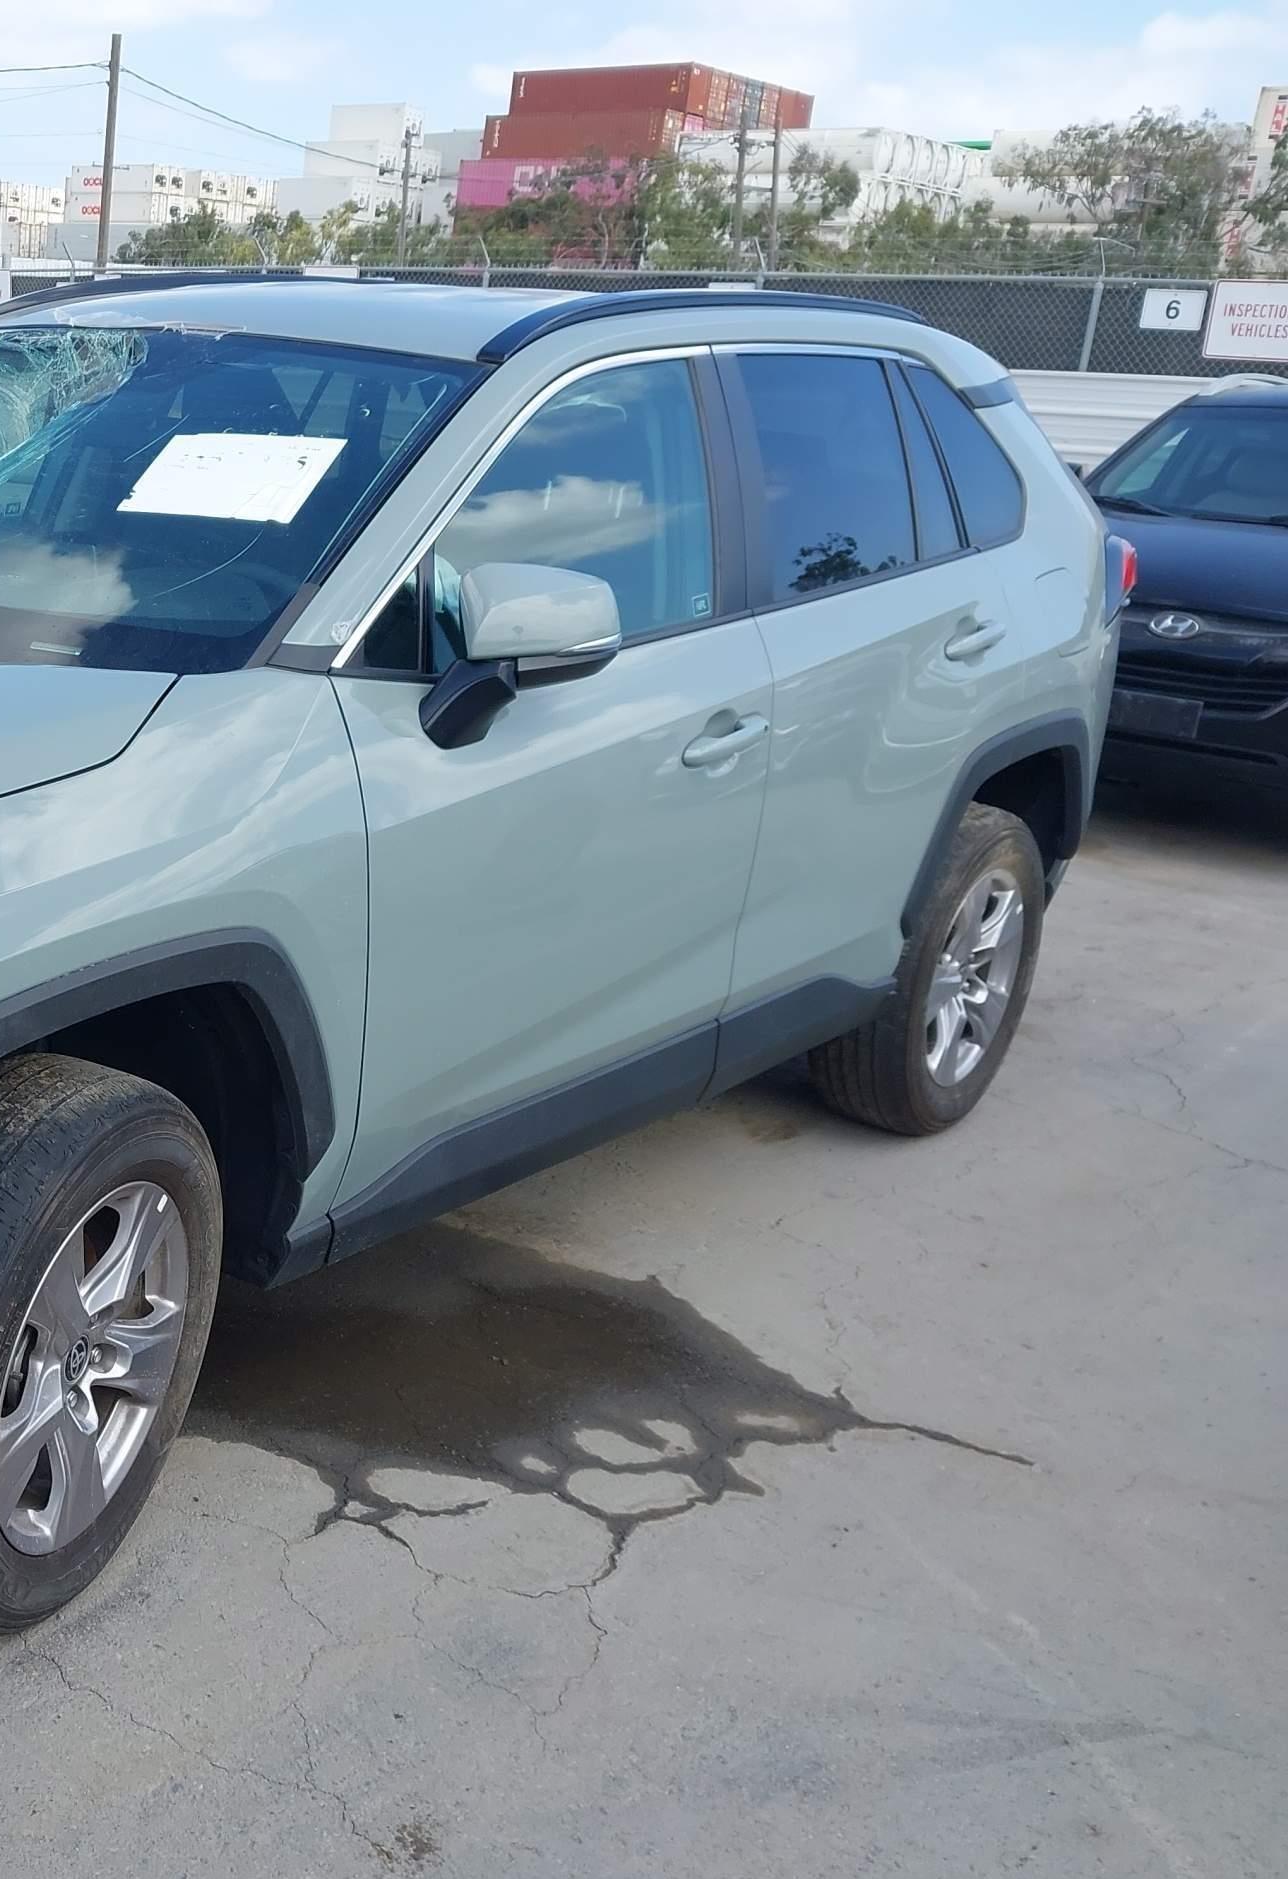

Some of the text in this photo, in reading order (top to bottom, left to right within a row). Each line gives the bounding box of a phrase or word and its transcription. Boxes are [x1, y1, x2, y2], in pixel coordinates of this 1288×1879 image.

[82, 206, 100, 215] OOC
[1165, 299, 1182, 320] 6
[1223, 303, 1288, 319] INSPECTIO
[1231, 322, 1288, 338] VEHICLES
